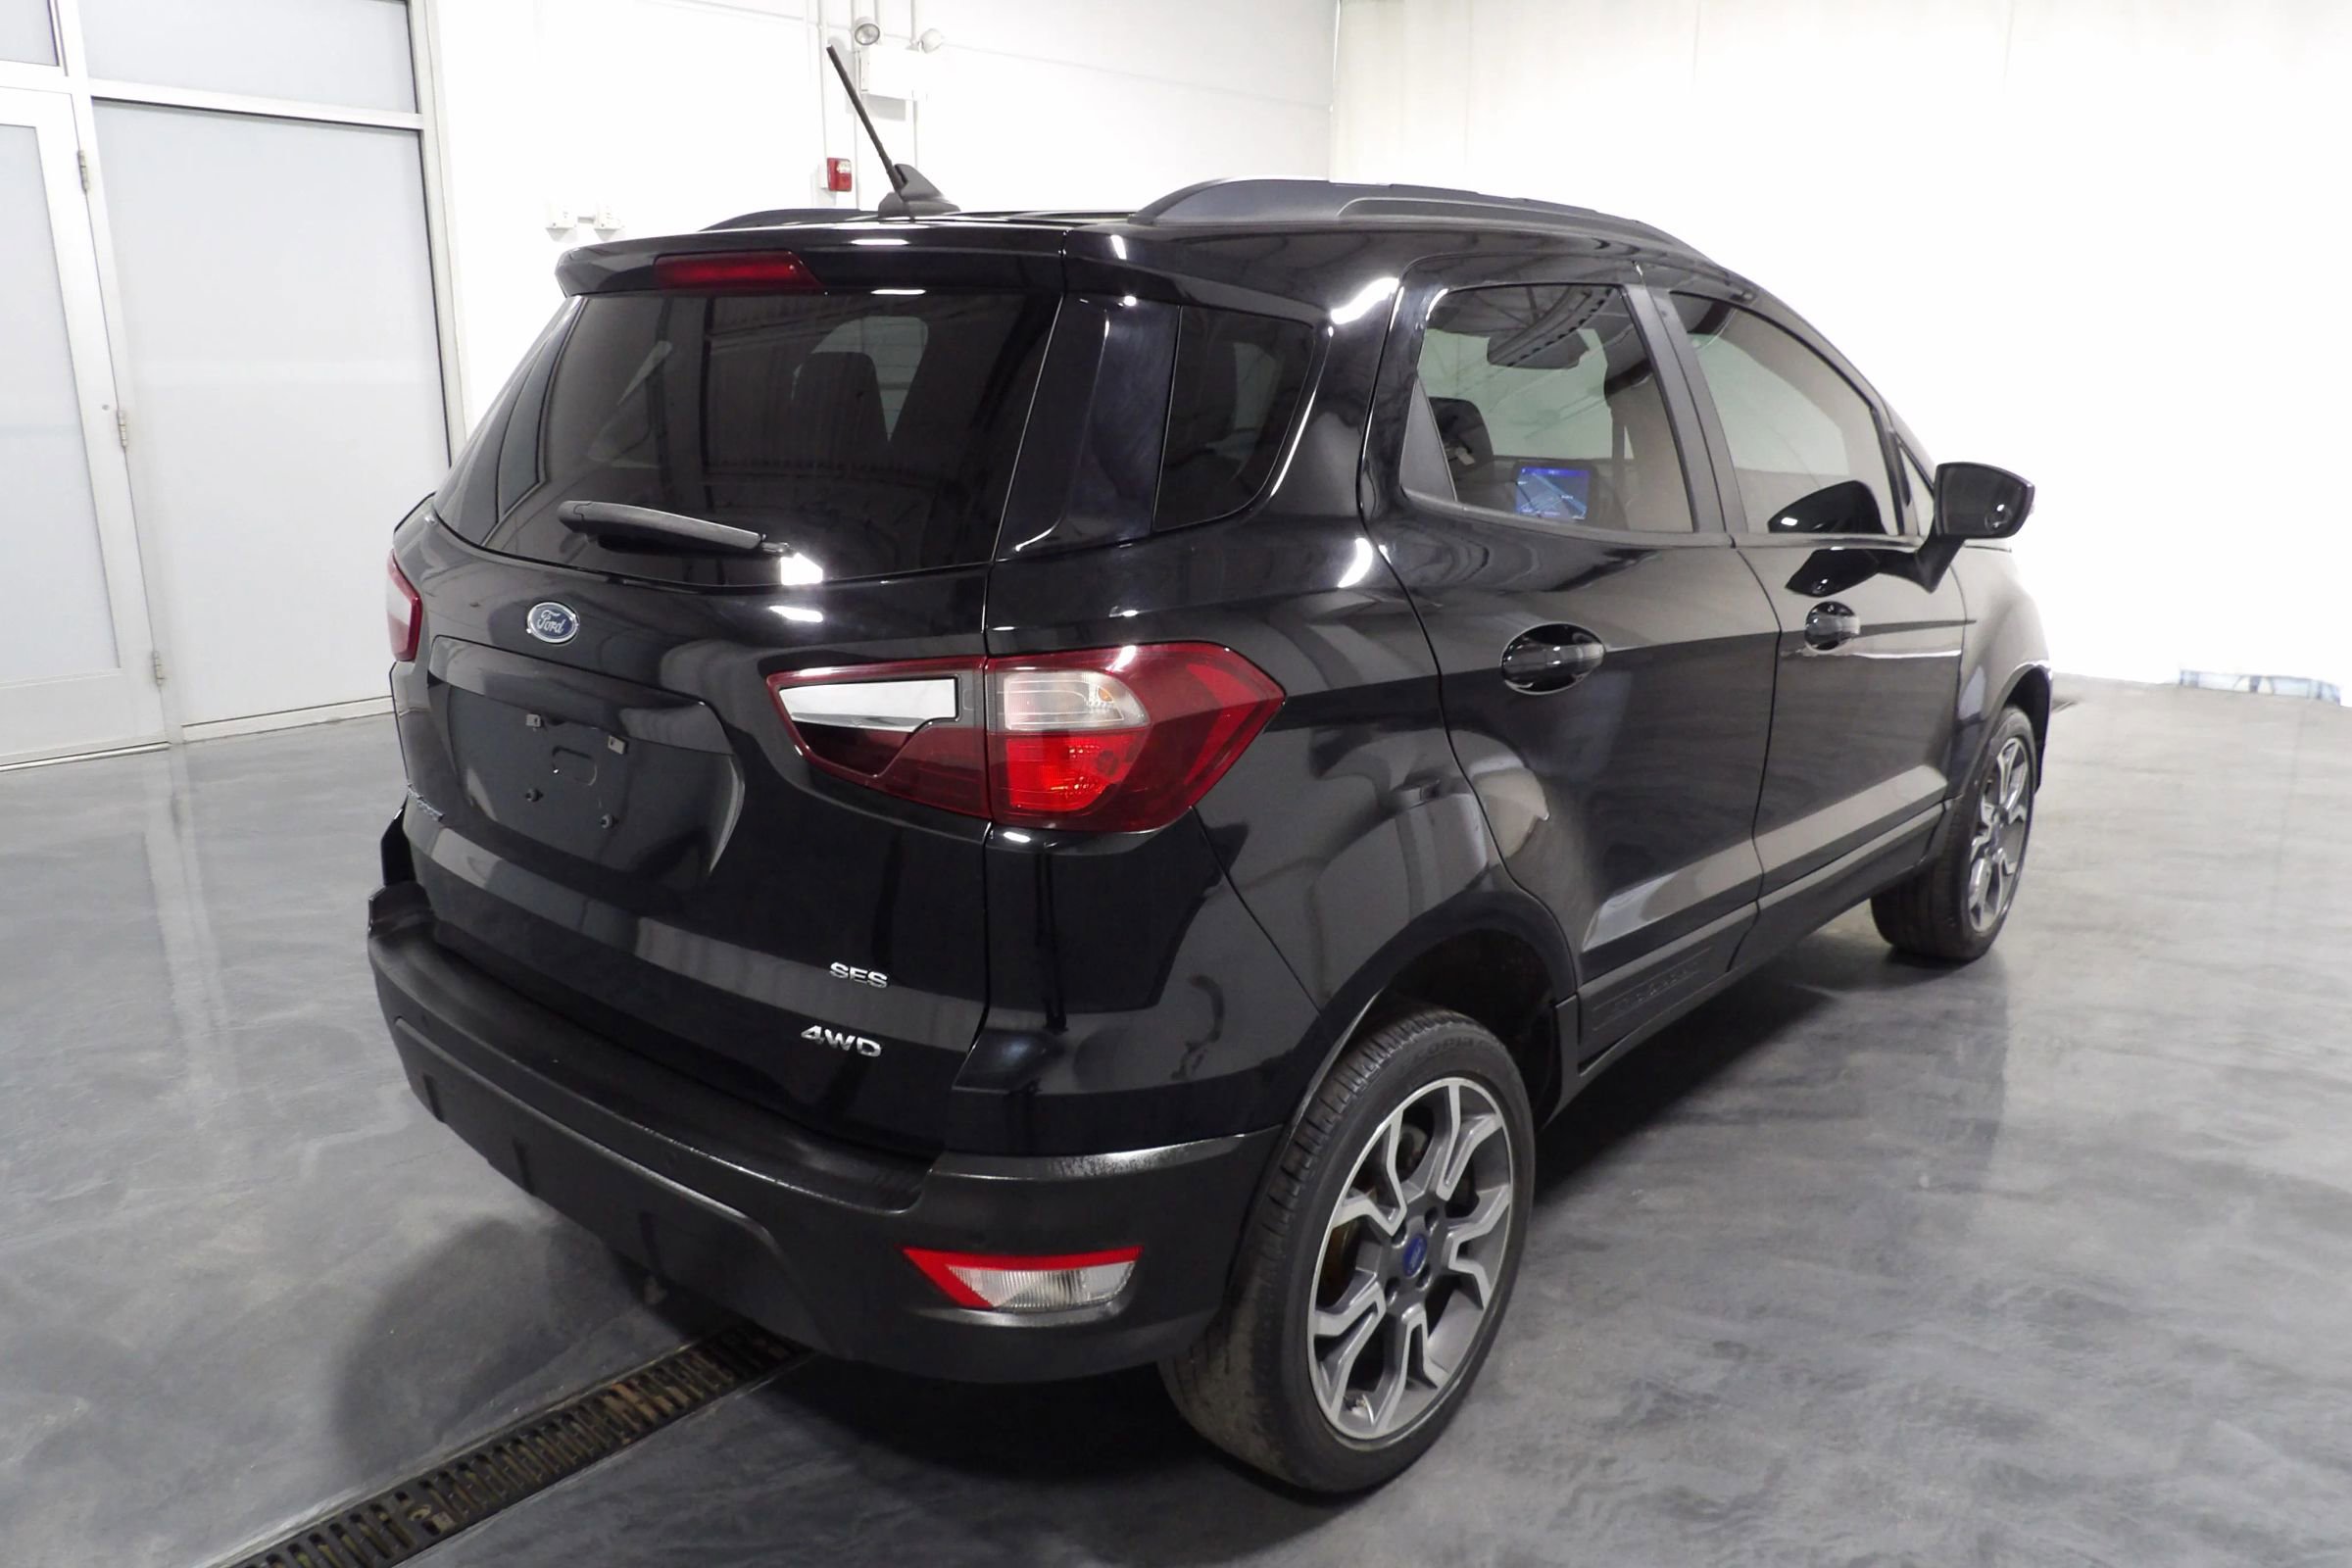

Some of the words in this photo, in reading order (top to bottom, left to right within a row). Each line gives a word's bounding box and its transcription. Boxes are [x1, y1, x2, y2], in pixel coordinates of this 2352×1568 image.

[536, 610, 566, 634] Ford
[829, 961, 888, 989] SES
[801, 1025, 882, 1057] 4WD
